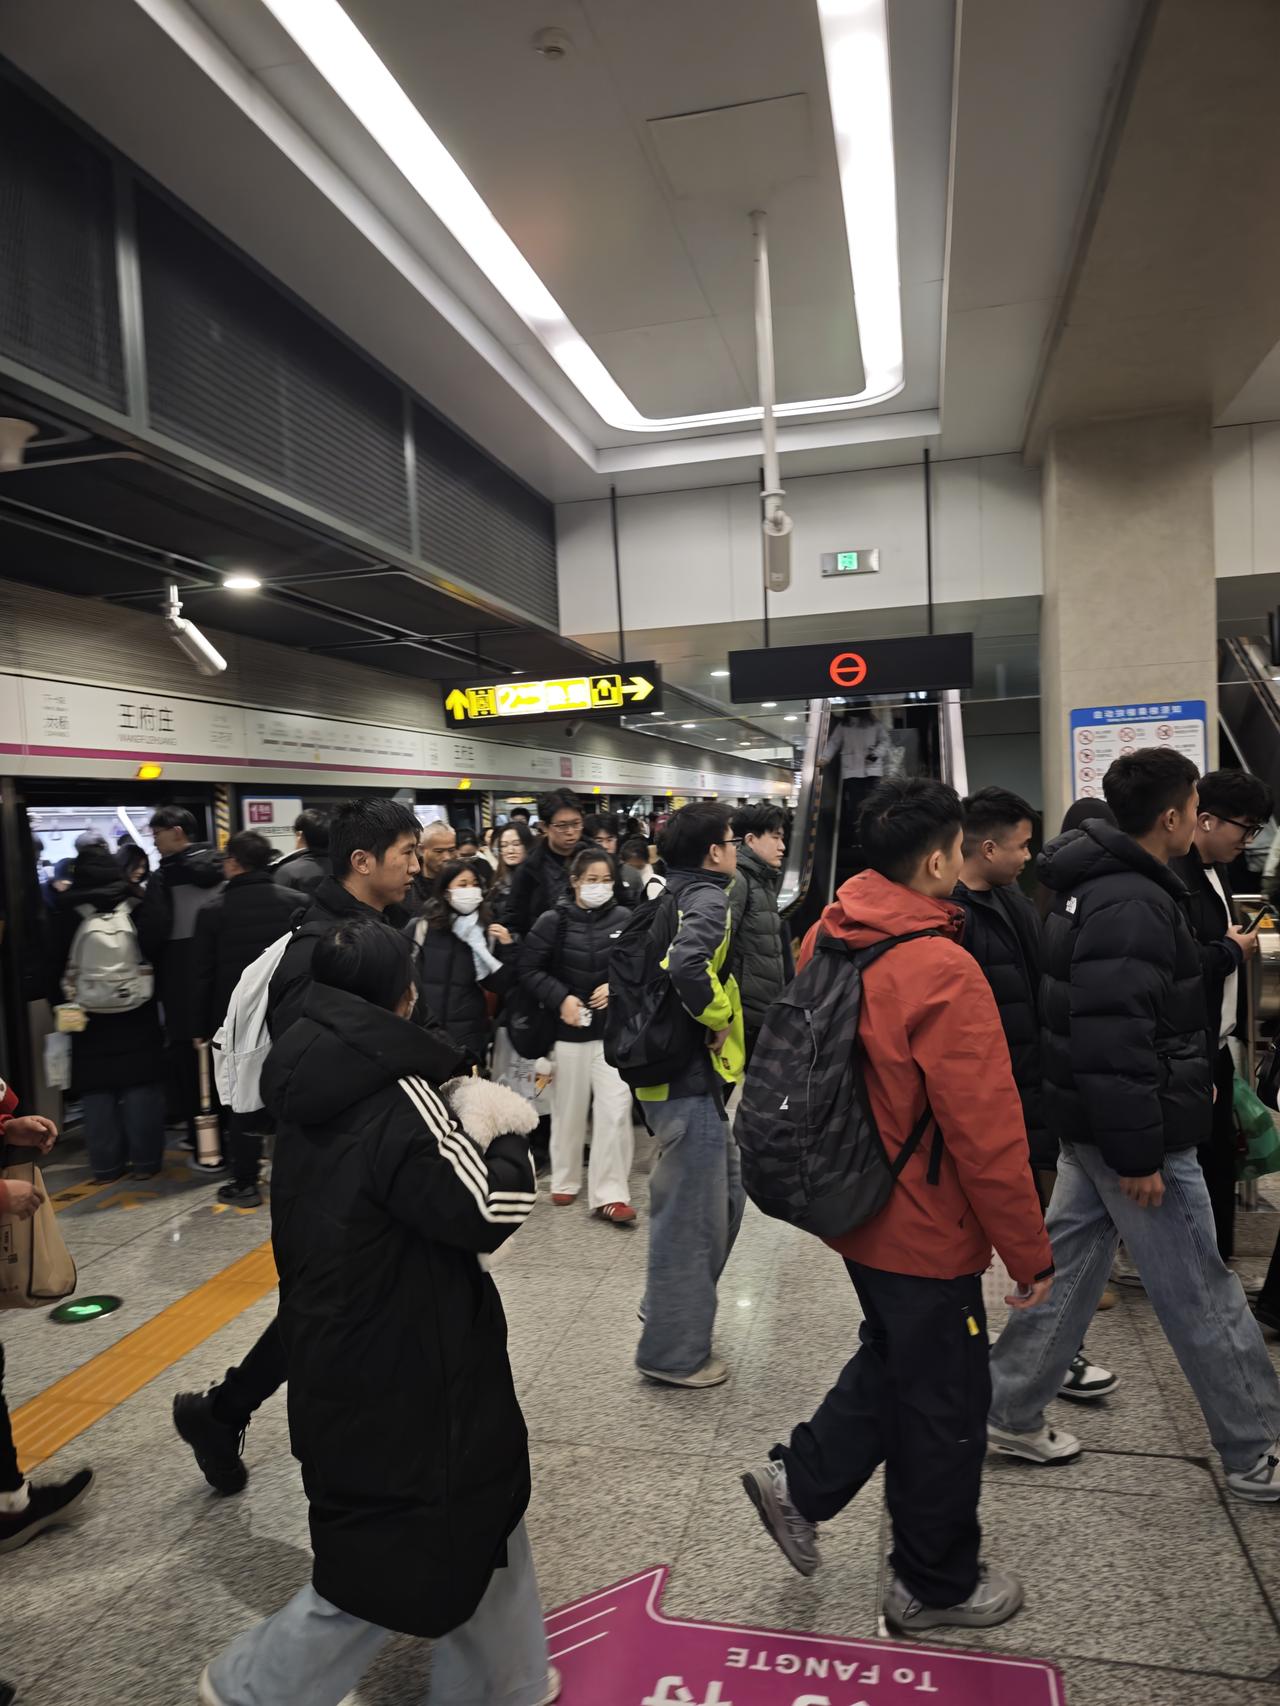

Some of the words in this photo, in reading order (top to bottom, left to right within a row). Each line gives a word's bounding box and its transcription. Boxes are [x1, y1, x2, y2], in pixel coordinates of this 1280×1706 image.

[117, 703, 176, 732] 王府庄
[725, 1646, 880, 1685] FANGTE
